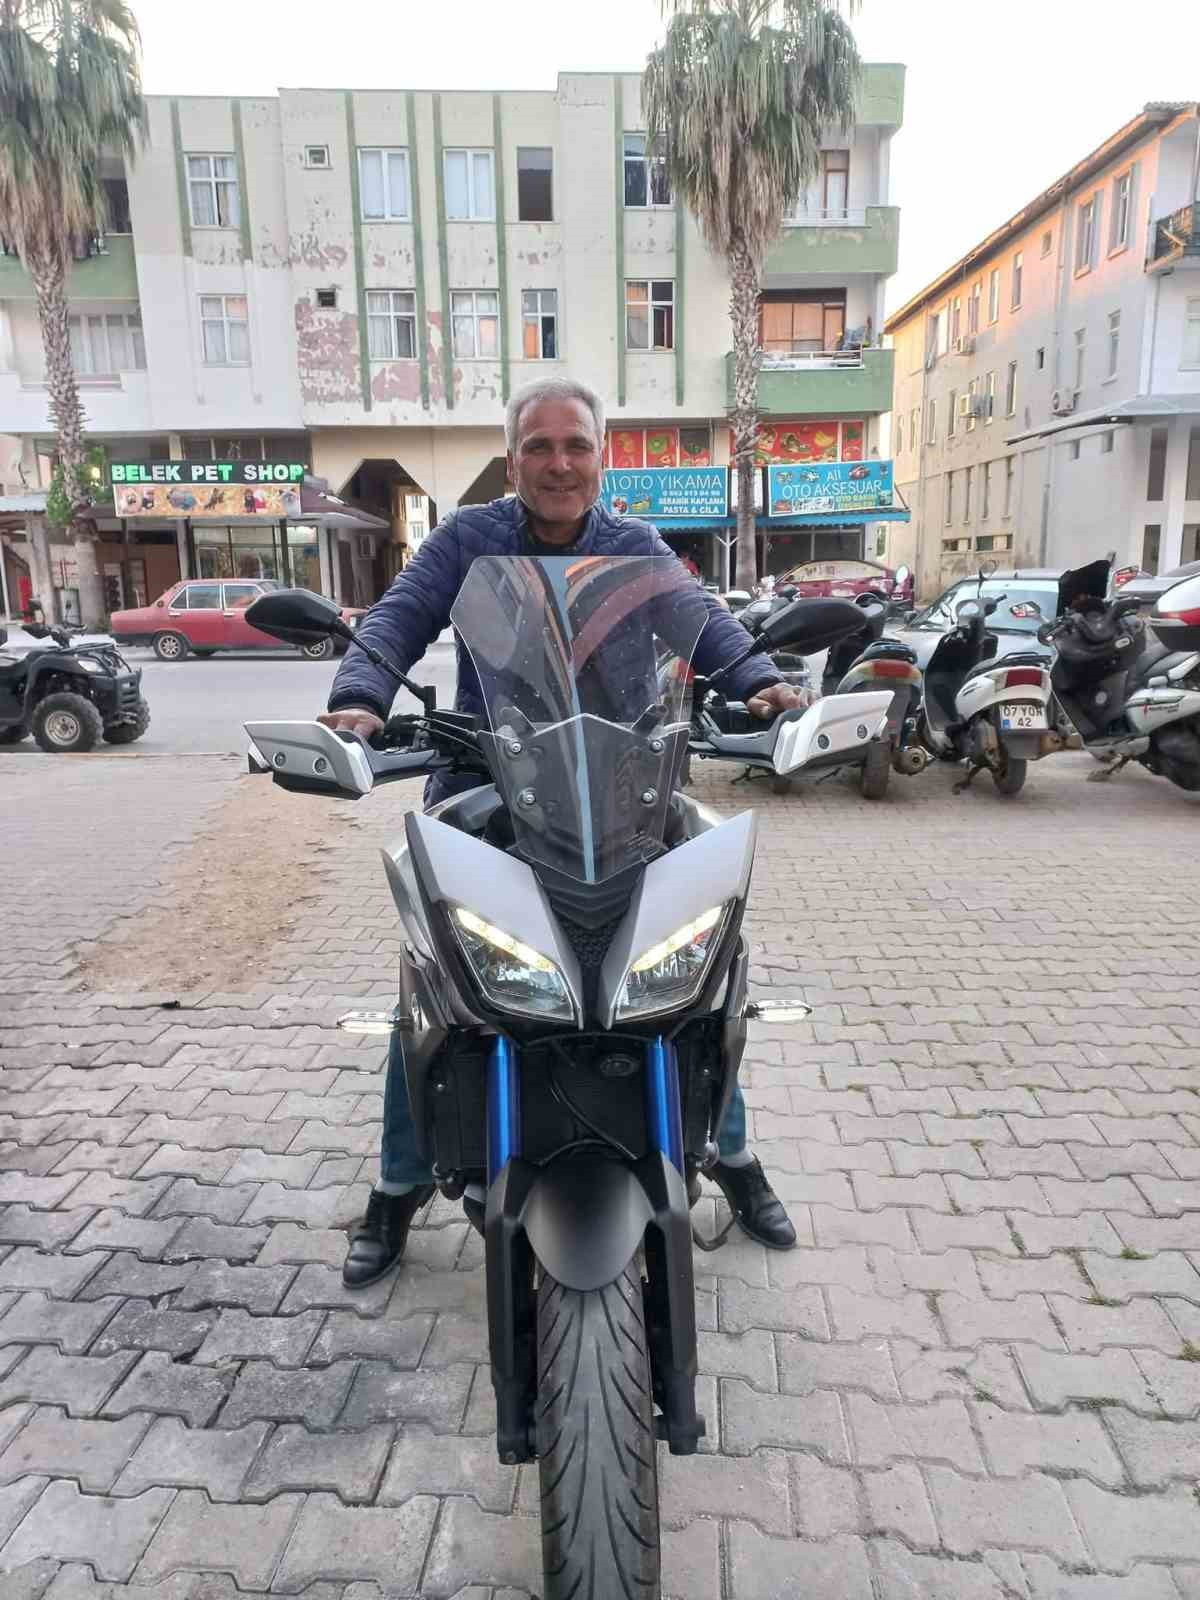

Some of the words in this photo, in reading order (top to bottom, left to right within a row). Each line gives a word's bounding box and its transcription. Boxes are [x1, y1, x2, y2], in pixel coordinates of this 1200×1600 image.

[111, 464, 182, 481] BELEK
[191, 464, 233, 481] PET
[244, 464, 303, 481] SHOP
[656, 474, 723, 489] YIKAMA
[782, 484, 812, 499] OTO
[814, 479, 883, 497] AKSESUAR
